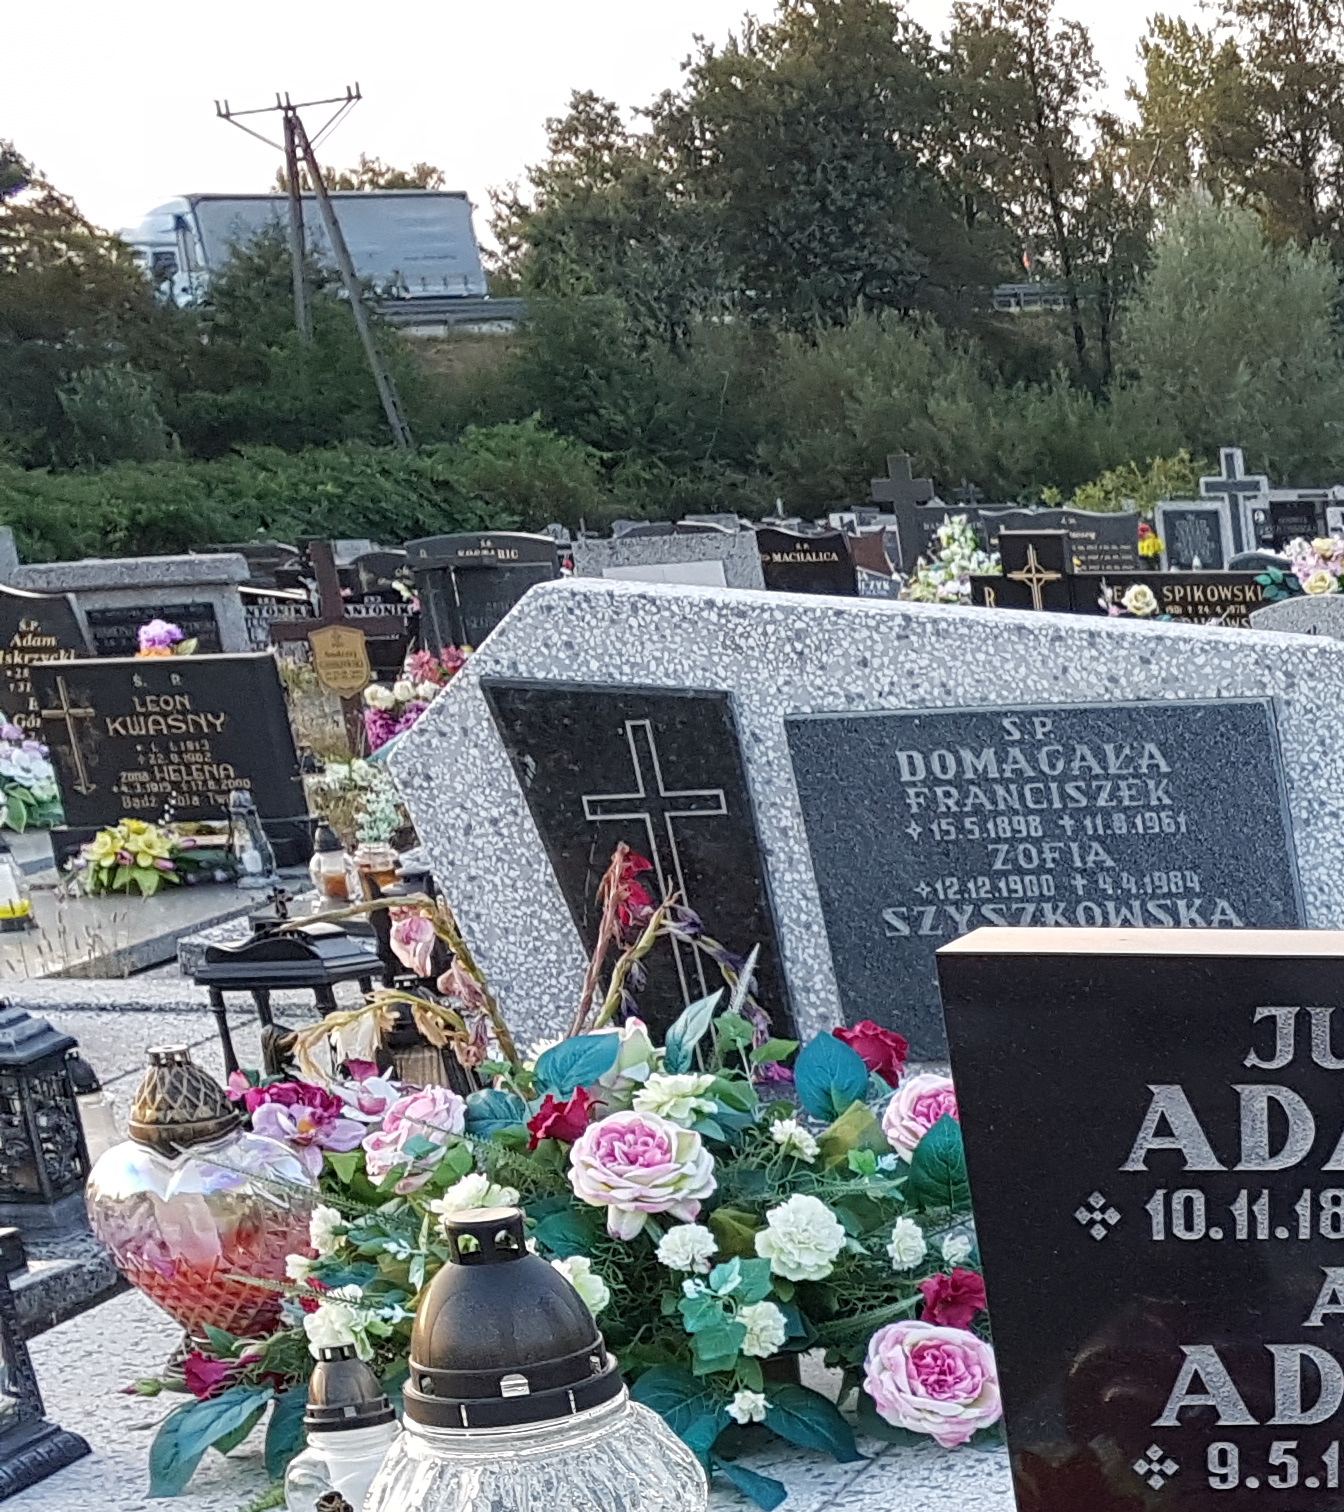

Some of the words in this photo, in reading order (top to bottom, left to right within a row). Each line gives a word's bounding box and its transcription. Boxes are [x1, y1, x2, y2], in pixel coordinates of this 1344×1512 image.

[772, 552, 839, 563] MACHALICA
[1162, 584, 1263, 602] SPIKOWSKI
[10, 633, 56, 647] Adam
[132, 694, 191, 713] LEON
[154, 762, 236, 782] HELENA
[905, 778, 1173, 814] FRANCISZEK
[930, 815, 1044, 841] 15.5.1898
[987, 841, 1117, 870] ZOFIA
[934, 874, 1056, 899] 12.12.1900
[1098, 870, 1201, 895] 4.4.1984
[881, 898, 1245, 937] SZYSZKOWSKA
